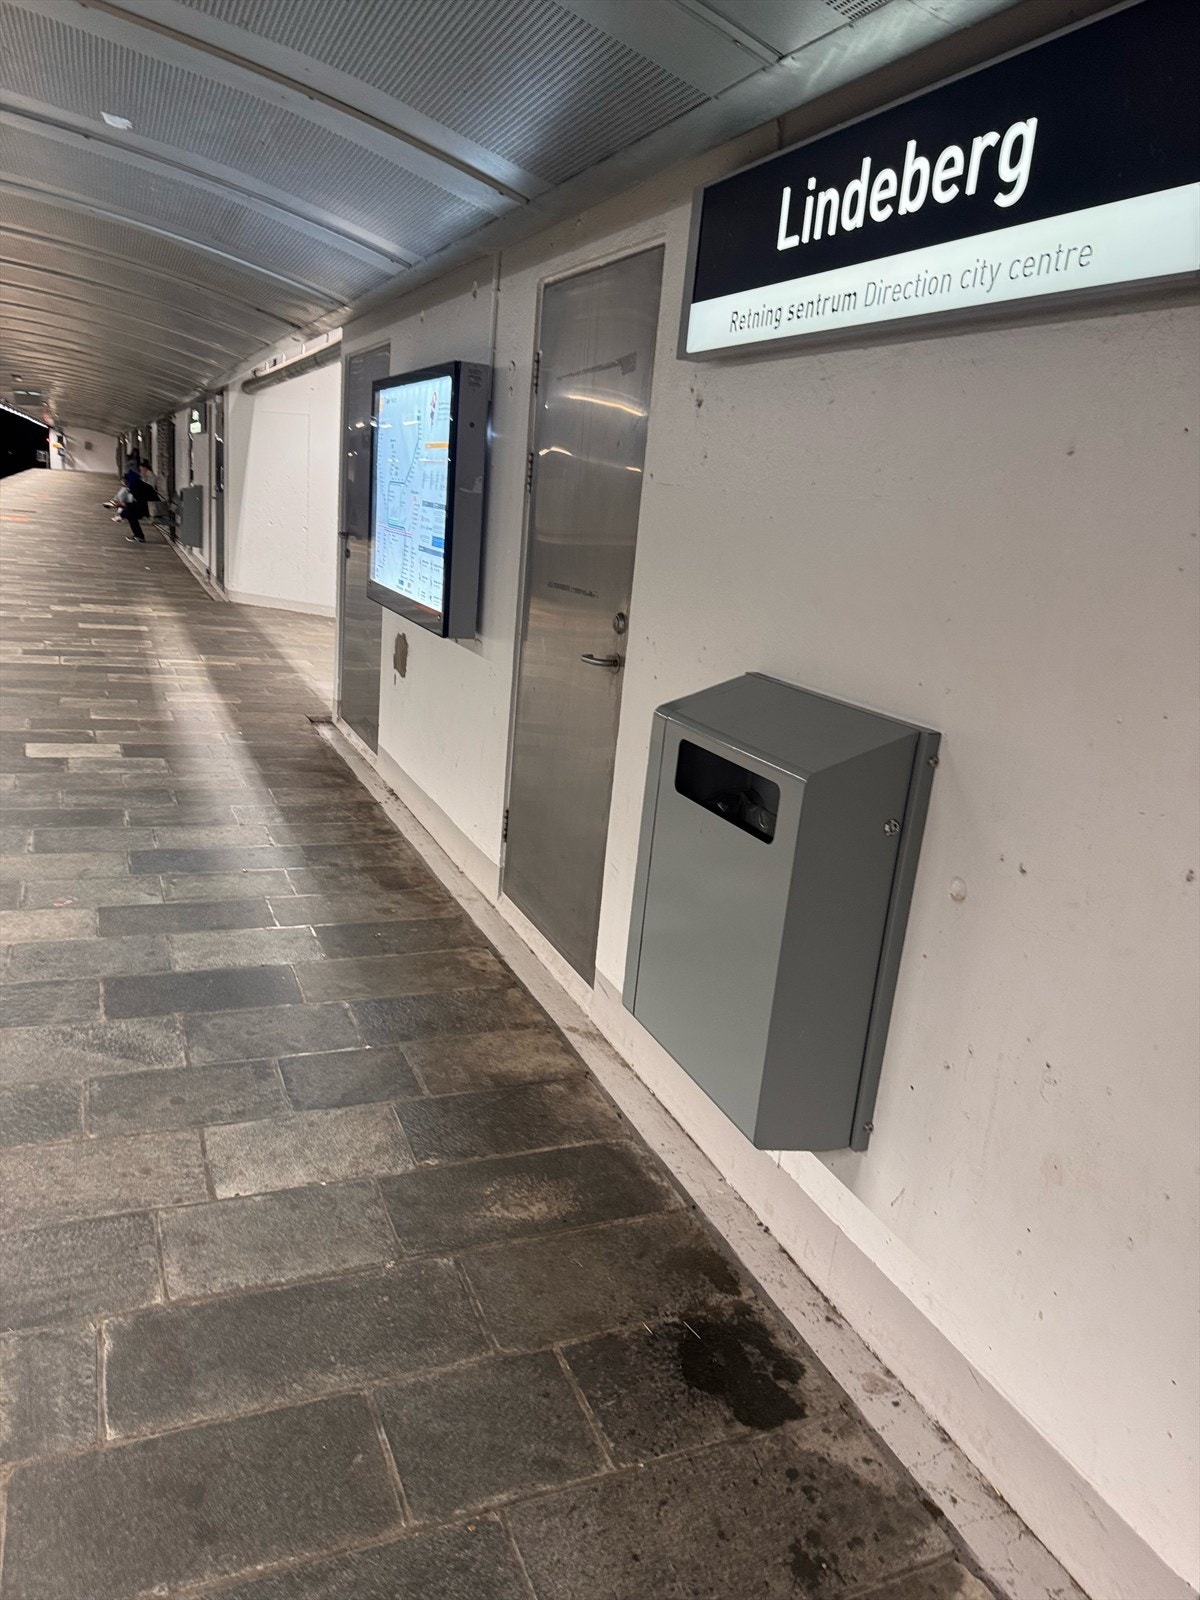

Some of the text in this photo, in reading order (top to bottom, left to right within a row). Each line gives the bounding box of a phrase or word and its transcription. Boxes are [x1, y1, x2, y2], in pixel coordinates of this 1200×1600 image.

[776, 117, 1038, 251] Lindeberg
[729, 242, 1094, 334] Retning sentrum Direction city centre
